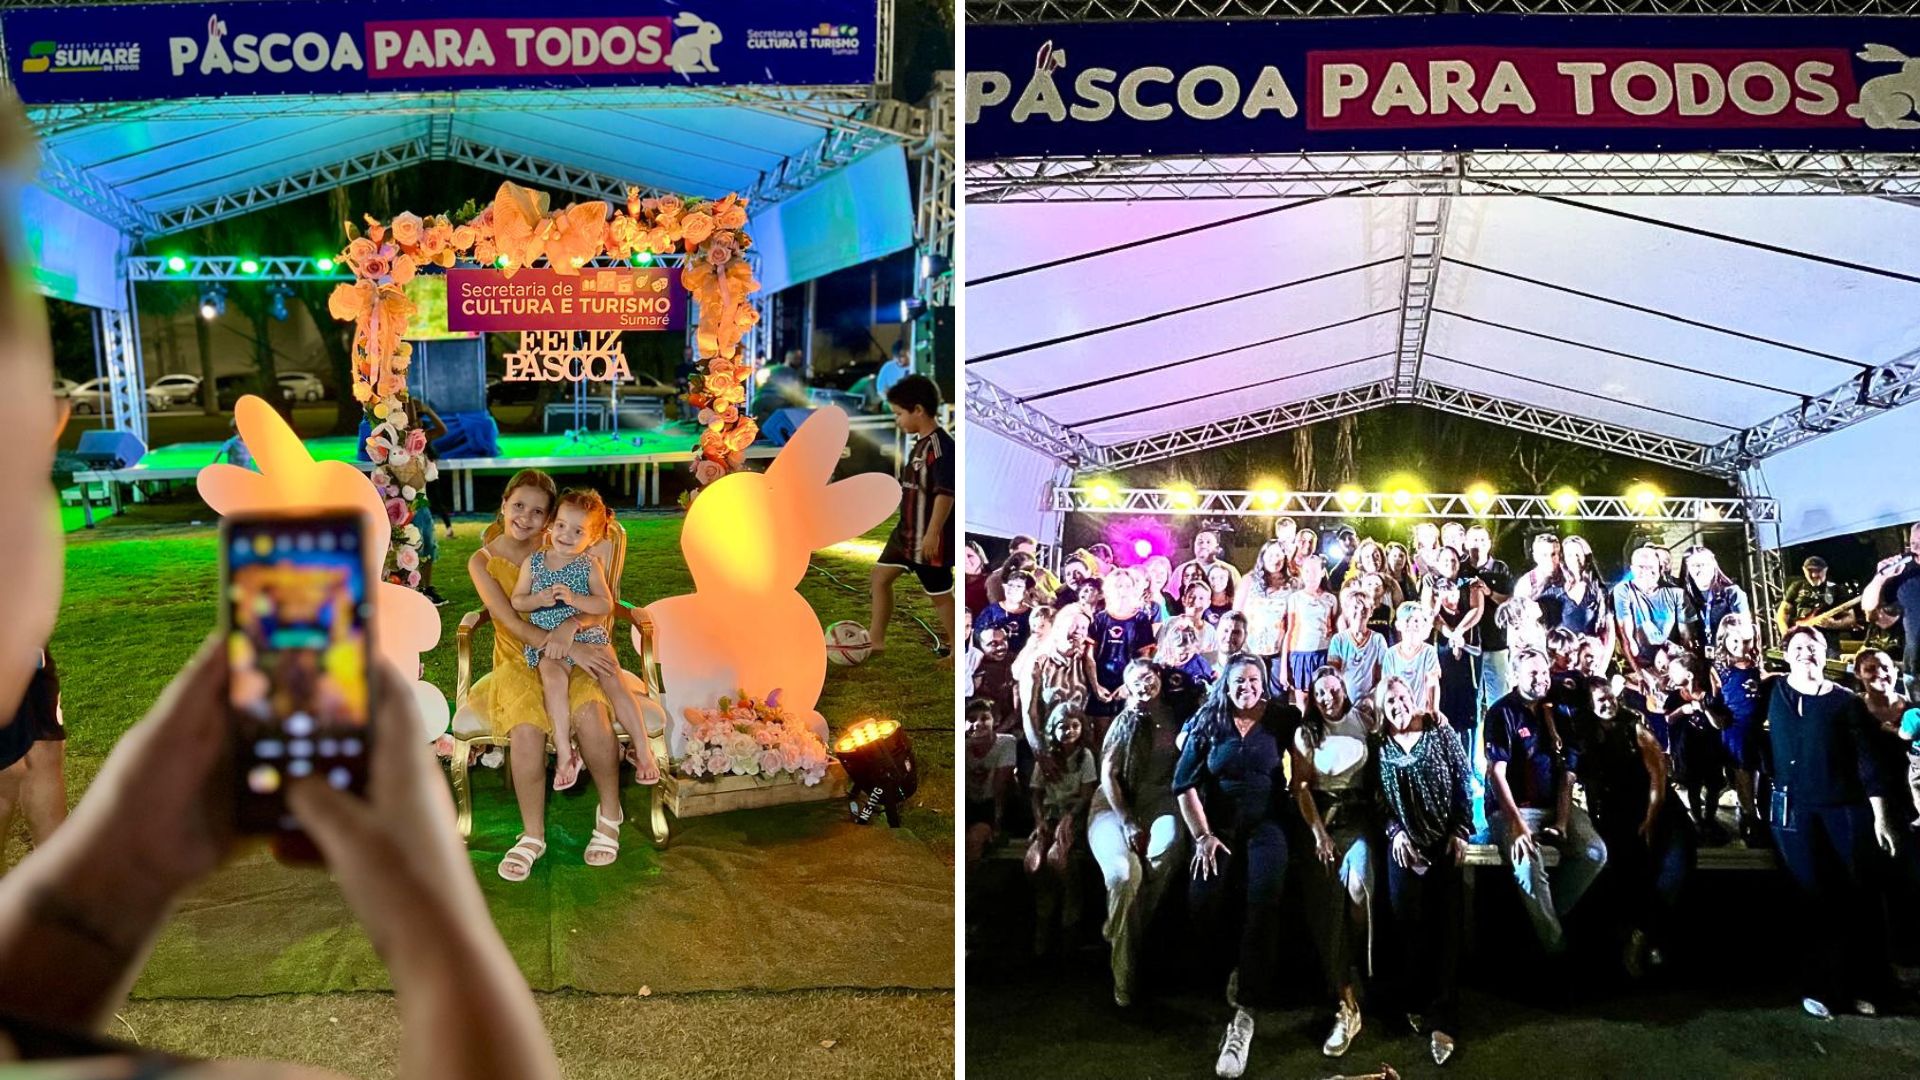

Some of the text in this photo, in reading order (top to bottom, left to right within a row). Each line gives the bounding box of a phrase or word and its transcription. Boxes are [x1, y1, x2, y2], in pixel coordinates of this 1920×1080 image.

[747, 29, 808, 38] Secretaria de
[373, 28, 496, 70] PARA
[506, 24, 664, 67] TODOS
[747, 38, 860, 49] CULTURA E TURISMO
[55, 43, 140, 66] SUMARÉ
[115, 64, 140, 72] TODOS
[1323, 60, 1537, 118] PARA
[1557, 61, 1839, 116] TODOS
[461, 281, 573, 297] Secretaria de
[461, 297, 671, 315] CULTURA E TURISMO
[620, 313, 670, 326] Sumaré
[517, 330, 624, 355] FELIZ
[502, 347, 635, 383] PÁSCOA
